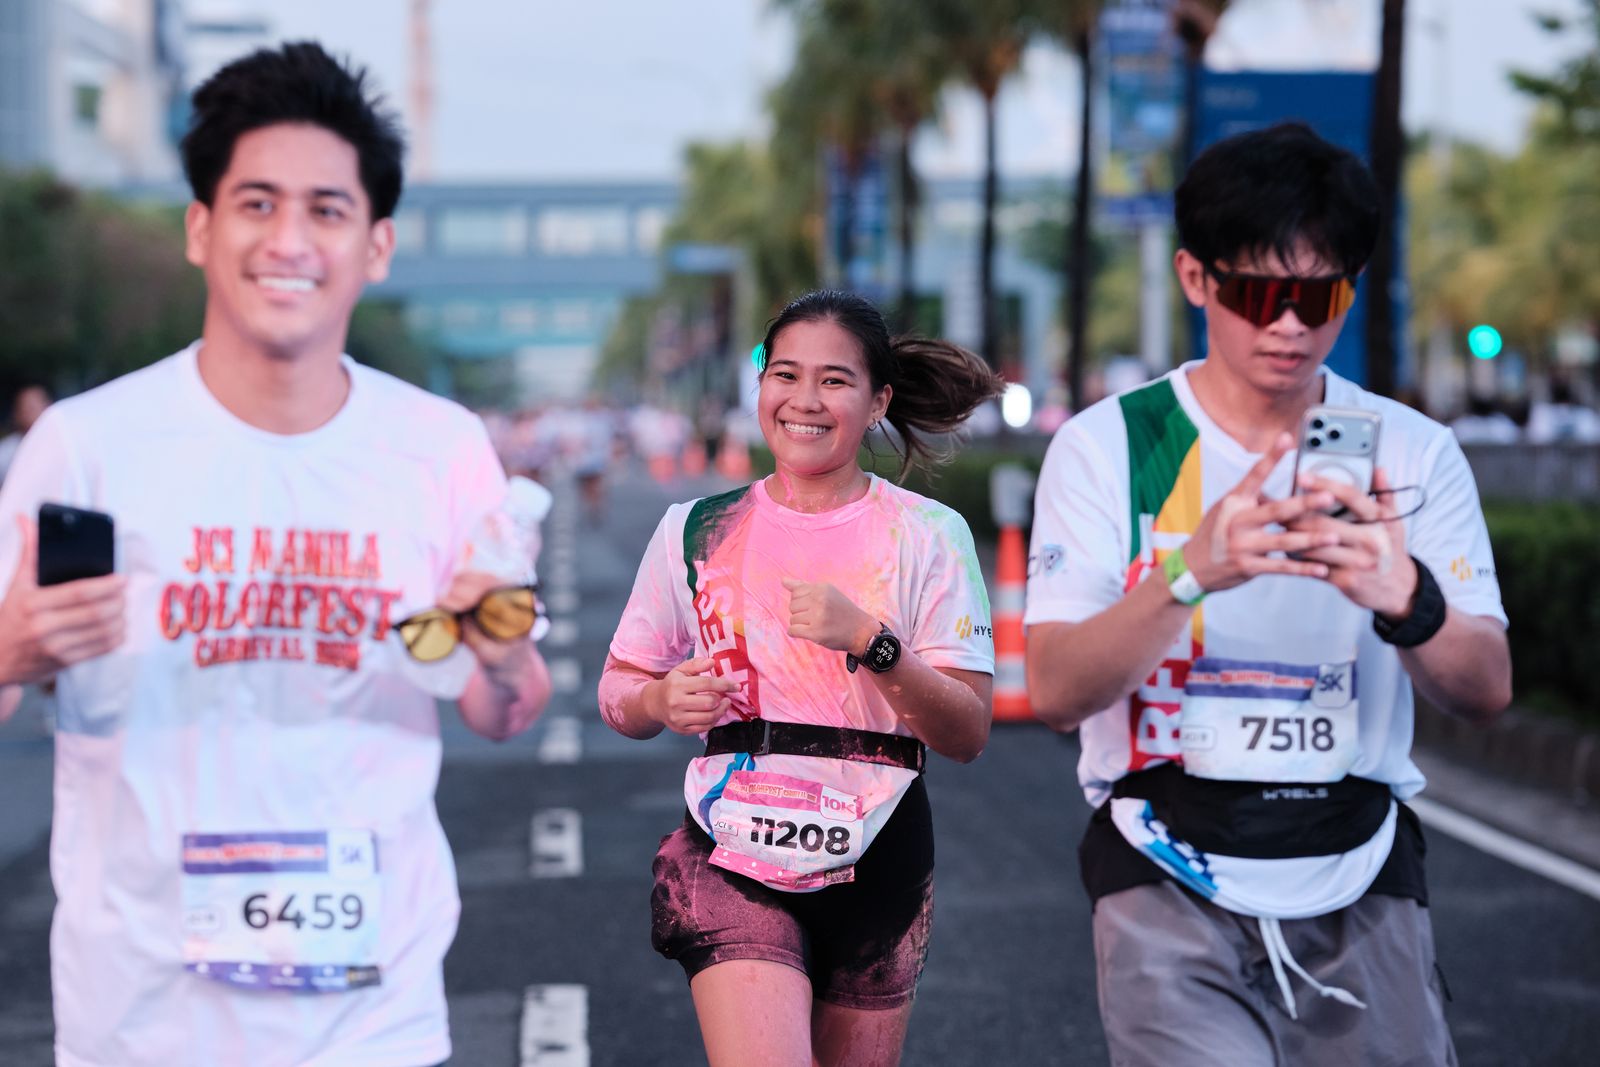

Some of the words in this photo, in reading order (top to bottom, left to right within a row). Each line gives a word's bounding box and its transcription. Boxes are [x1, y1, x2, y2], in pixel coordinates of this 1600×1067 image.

[249, 527, 382, 579] MANILA
[160, 581, 403, 641] COLORFEST
[195, 635, 304, 668] CARNIVAL
[1319, 673, 1344, 691] 5K
[1240, 716, 1335, 752] 7518
[822, 795, 855, 814] 10K
[751, 816, 850, 856] 11208
[243, 894, 363, 930] 6459
